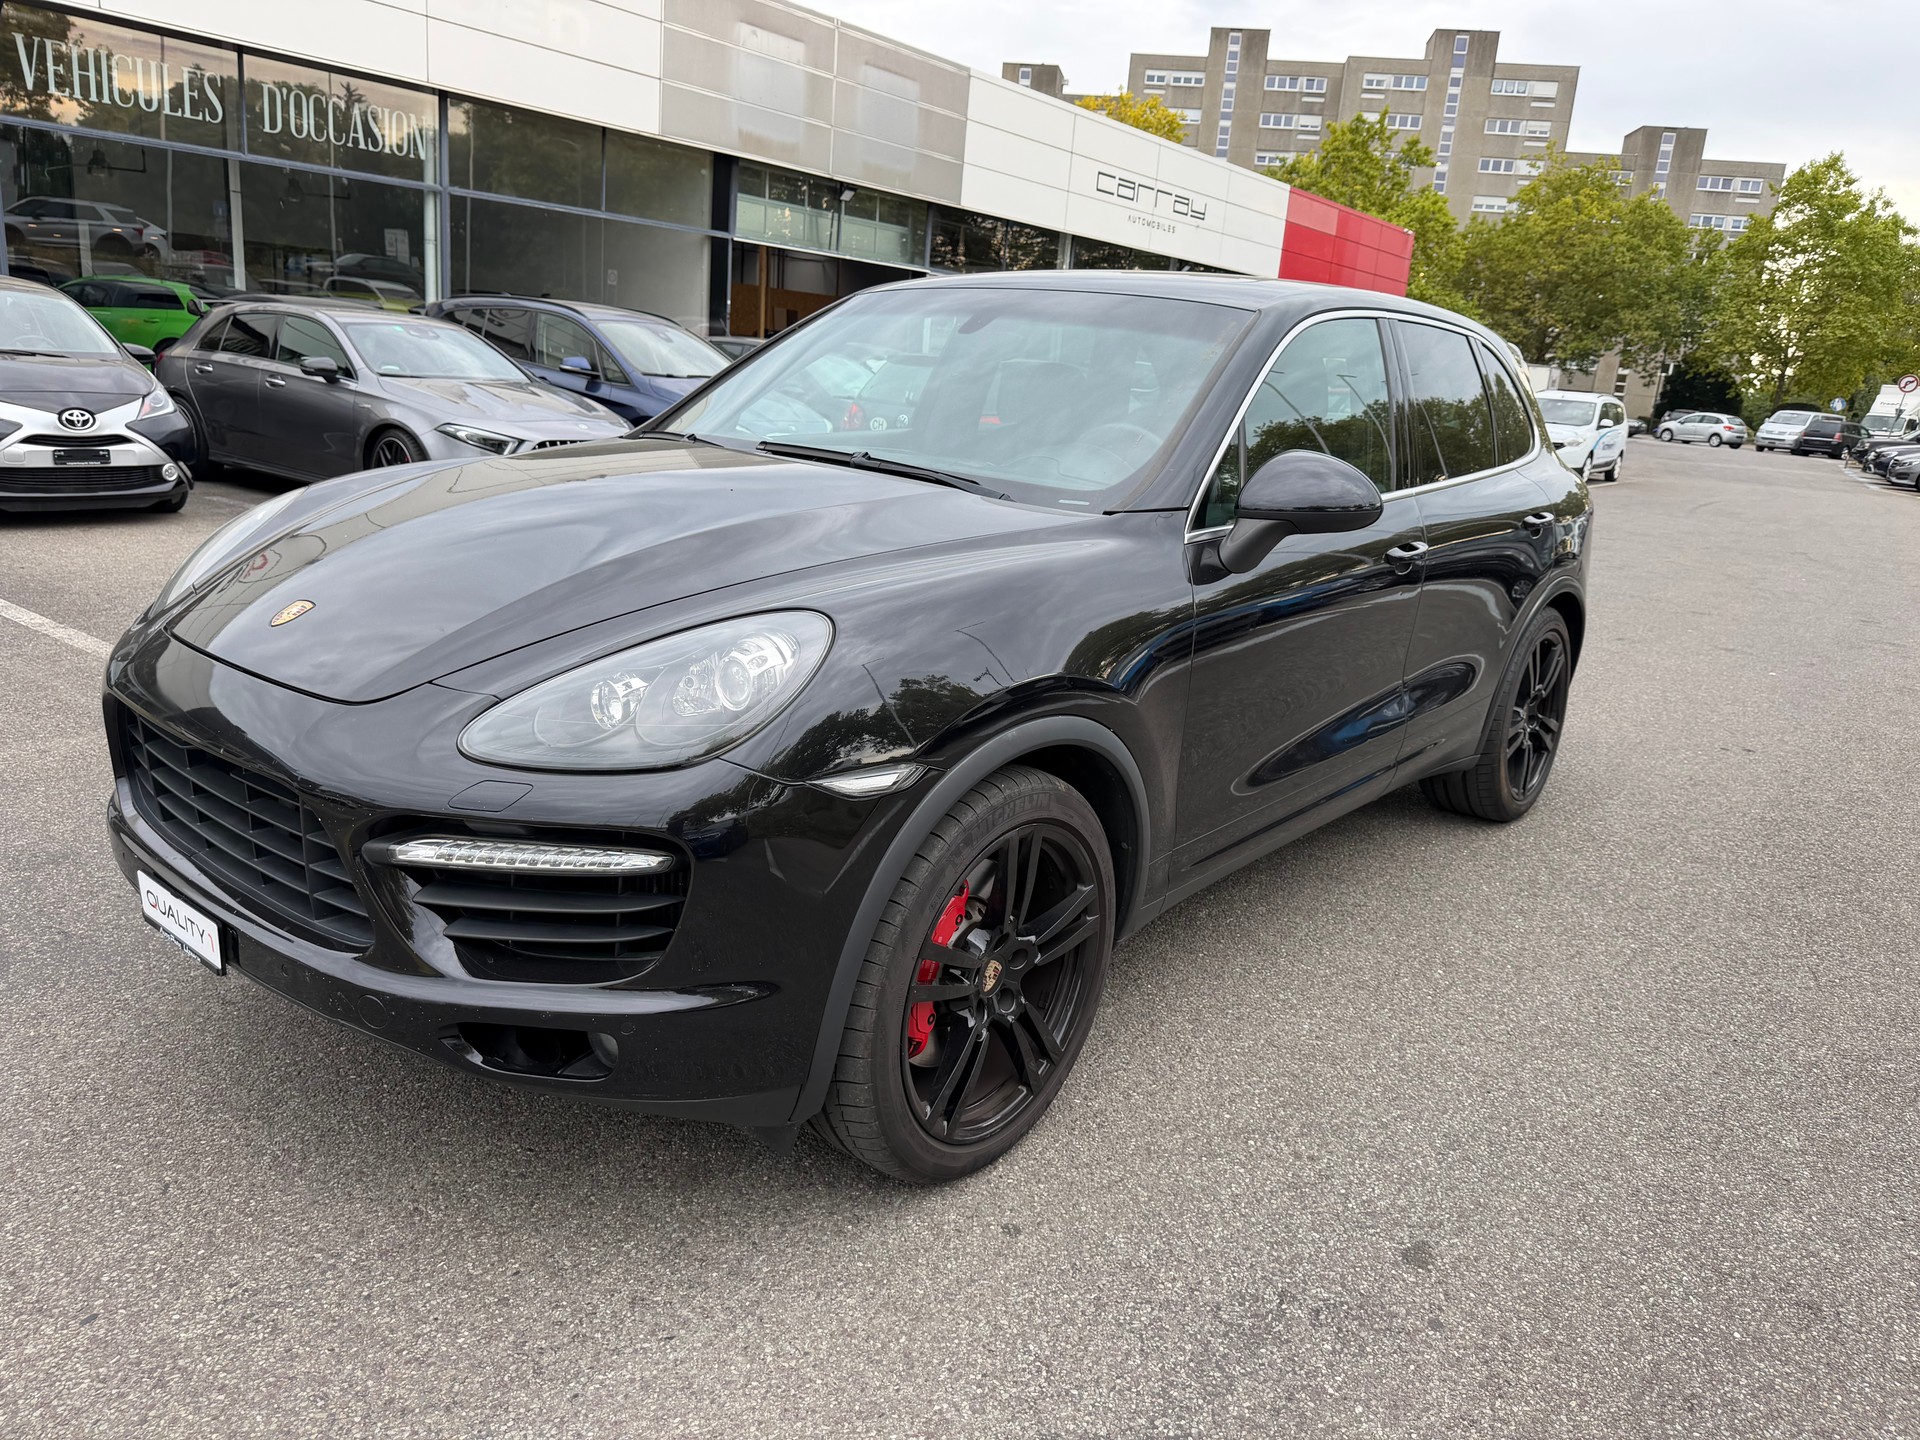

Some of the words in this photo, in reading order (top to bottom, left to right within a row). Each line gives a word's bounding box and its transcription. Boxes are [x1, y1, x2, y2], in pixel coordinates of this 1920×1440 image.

[11, 32, 224, 124] VEHICULES
[261, 83, 427, 160] D'OCCASION
[1096, 171, 1207, 221] carray
[1127, 214, 1176, 234] AUTOMOBILES
[870, 418, 886, 431] CH
